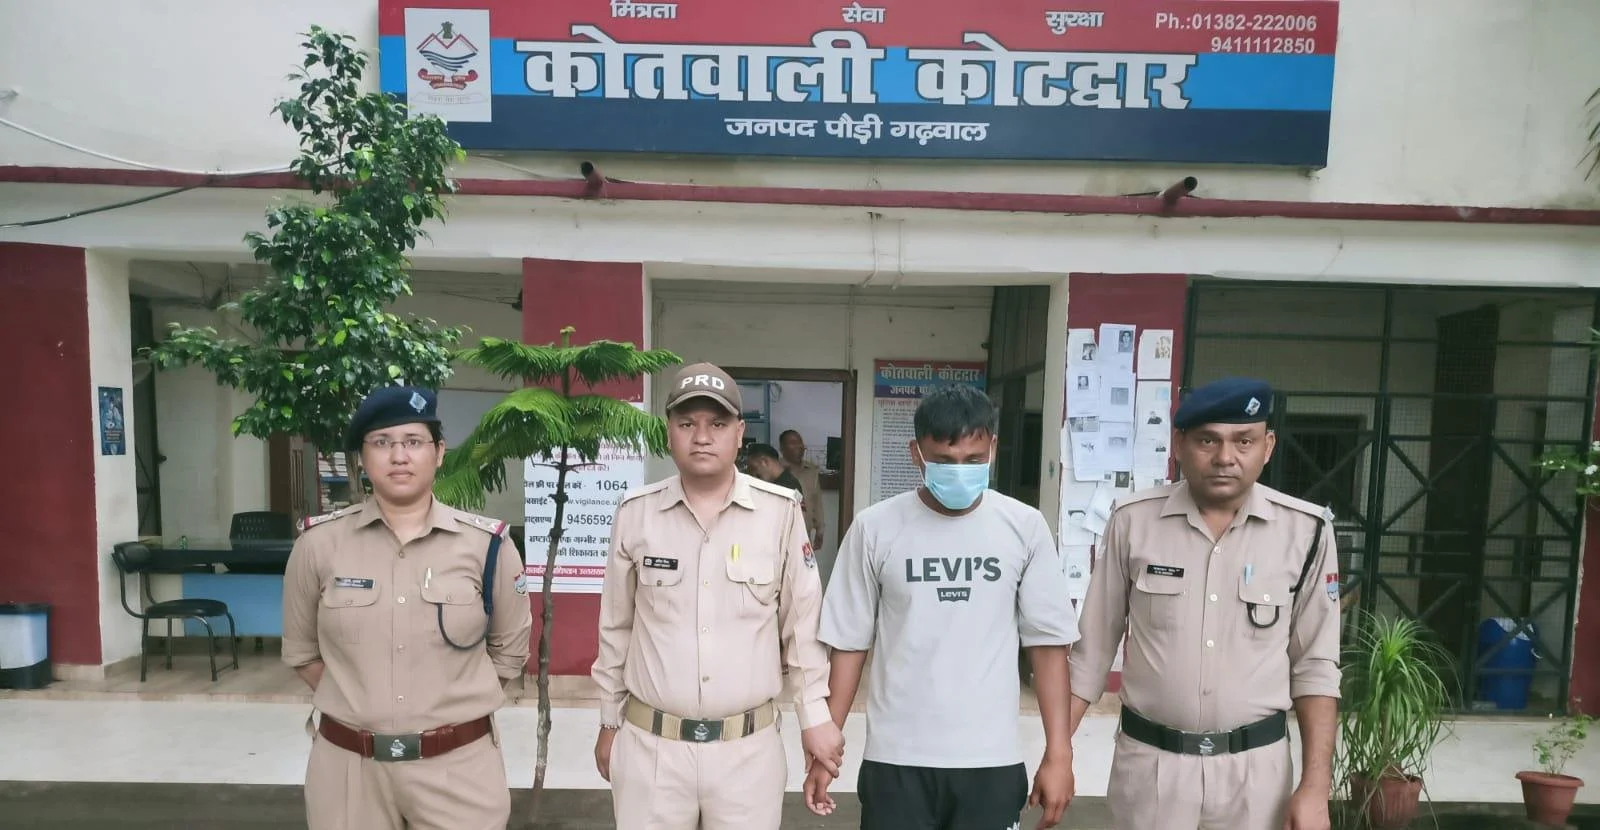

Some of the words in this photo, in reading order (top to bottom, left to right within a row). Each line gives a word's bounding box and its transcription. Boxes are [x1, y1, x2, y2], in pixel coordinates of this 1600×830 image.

[609, 0, 678, 19] मित्रता
[842, 1, 886, 24] सेवा
[1045, 10, 1105, 35] सुरक्षा
[1155, 12, 1318, 32] Ph.:01382-222006
[1210, 36, 1316, 54] 9411112850
[514, 23, 887, 105] कोतवाली
[907, 31, 1197, 111] कोटद्वार
[723, 117, 818, 138] जनपद
[825, 112, 883, 145] पौड़ी
[889, 120, 990, 146] गढ़वाल
[879, 362, 935, 380] कोतवाली
[679, 374, 725, 391] PRD
[889, 384, 916, 395] जनपद
[595, 480, 629, 491] 1064
[567, 514, 613, 525] 9456592
[905, 556, 1002, 583] LEVI'S
